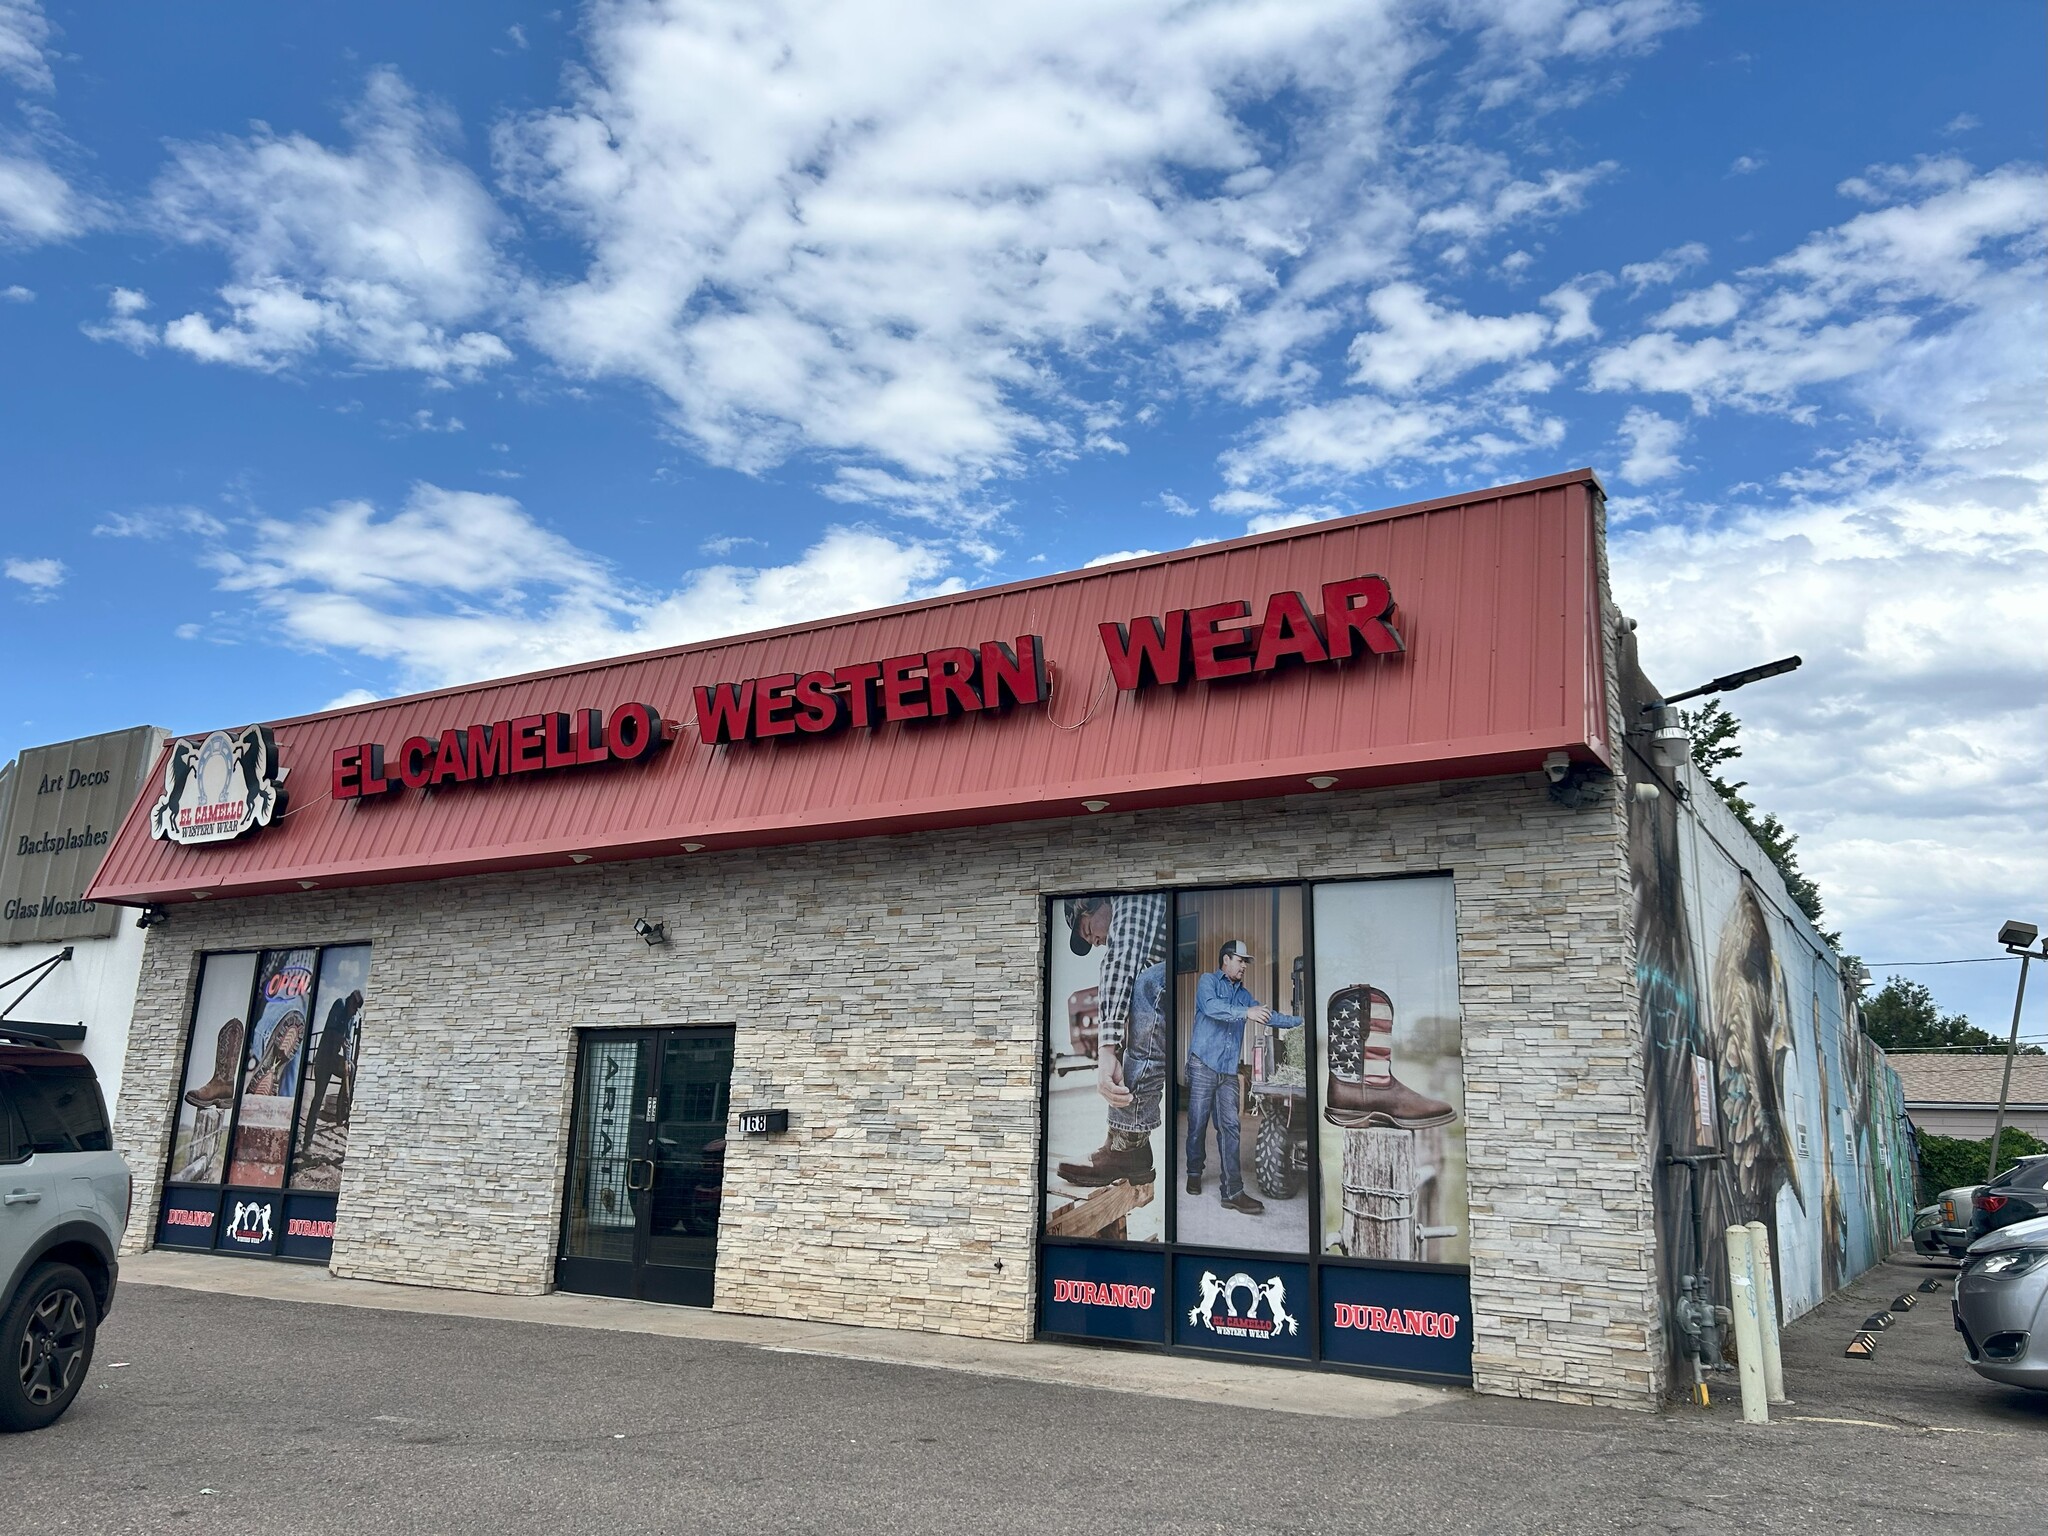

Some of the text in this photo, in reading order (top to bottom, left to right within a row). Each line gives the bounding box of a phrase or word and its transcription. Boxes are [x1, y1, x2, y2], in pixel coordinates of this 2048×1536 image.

[333, 574, 1405, 800] EL CAMELLO WESTERN WEAR
[38, 768, 110, 794] Art Decos
[179, 800, 244, 826] EL CAMELLO
[17, 824, 108, 855] Backsplashes
[182, 820, 239, 838] WESTERN WEAR
[4, 893, 96, 920] Glass Mosaics
[268, 973, 311, 997] OPEN
[601, 1055, 619, 1184] ARIAT
[743, 1115, 765, 1131] 168
[167, 1209, 214, 1227] DURANGO
[1054, 1280, 1154, 1310] DURANGO
[1213, 1316, 1272, 1331] EL CAMELLO
[1216, 1326, 1269, 1339] WESTERN WEAR
[1334, 1303, 1458, 1339] DURANGO
